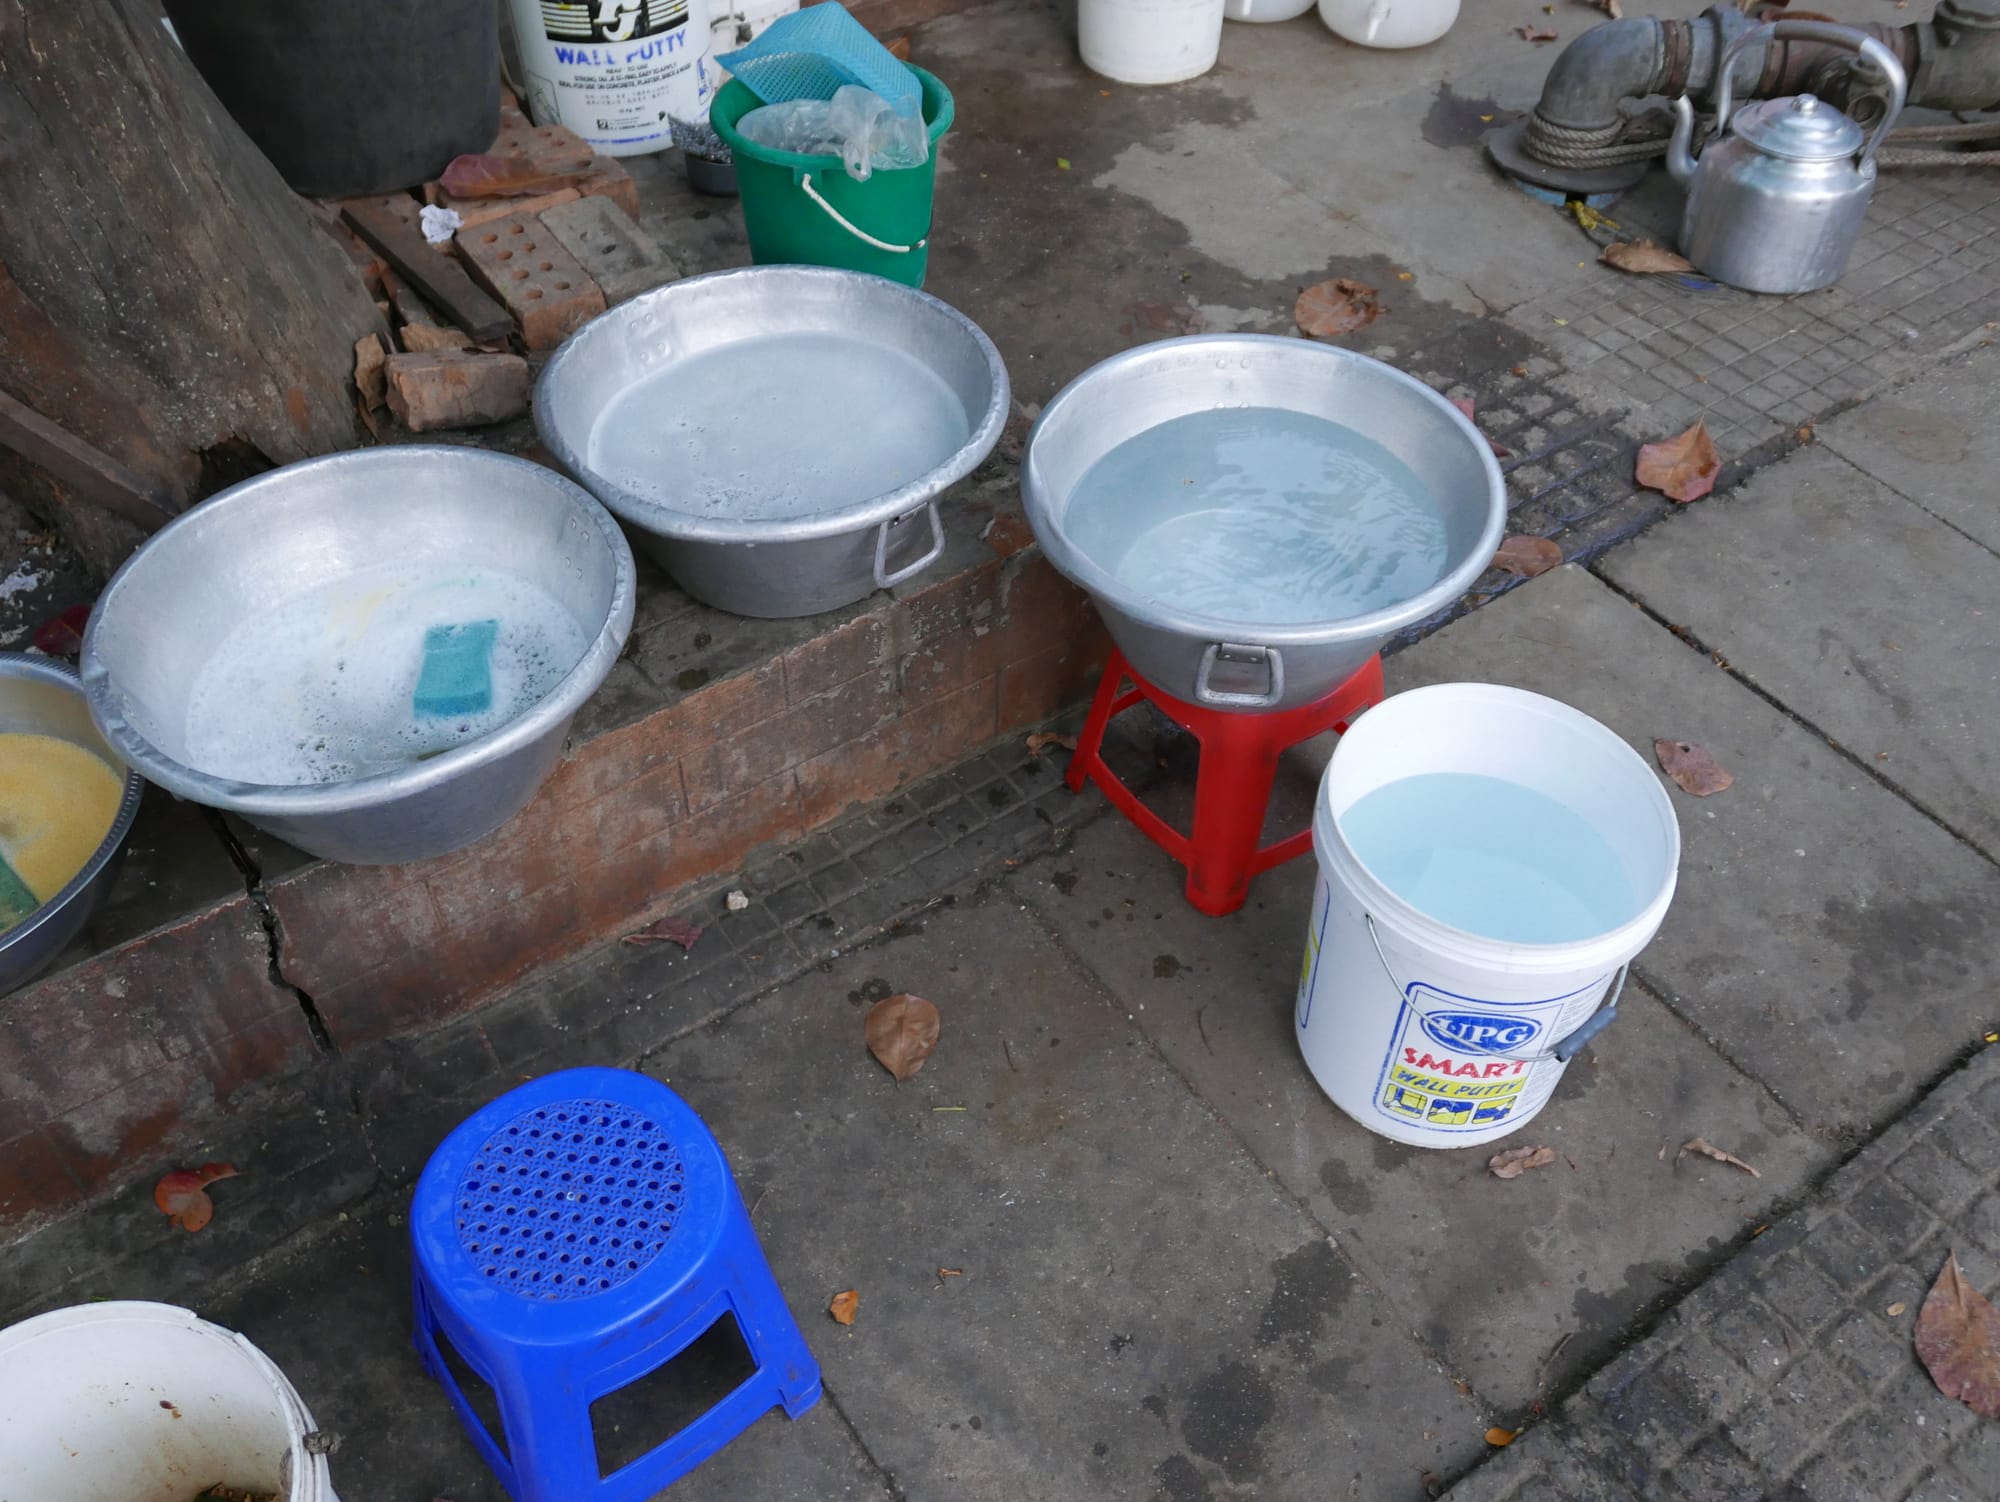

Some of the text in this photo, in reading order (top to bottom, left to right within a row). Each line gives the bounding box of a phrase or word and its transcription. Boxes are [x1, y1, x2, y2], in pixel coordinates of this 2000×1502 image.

[1431, 1016, 1529, 1044] UPG
[1404, 1047, 1528, 1078] SMART
[1397, 1070, 1450, 1093] WALL
[1455, 1079, 1523, 1096] PUTTY
